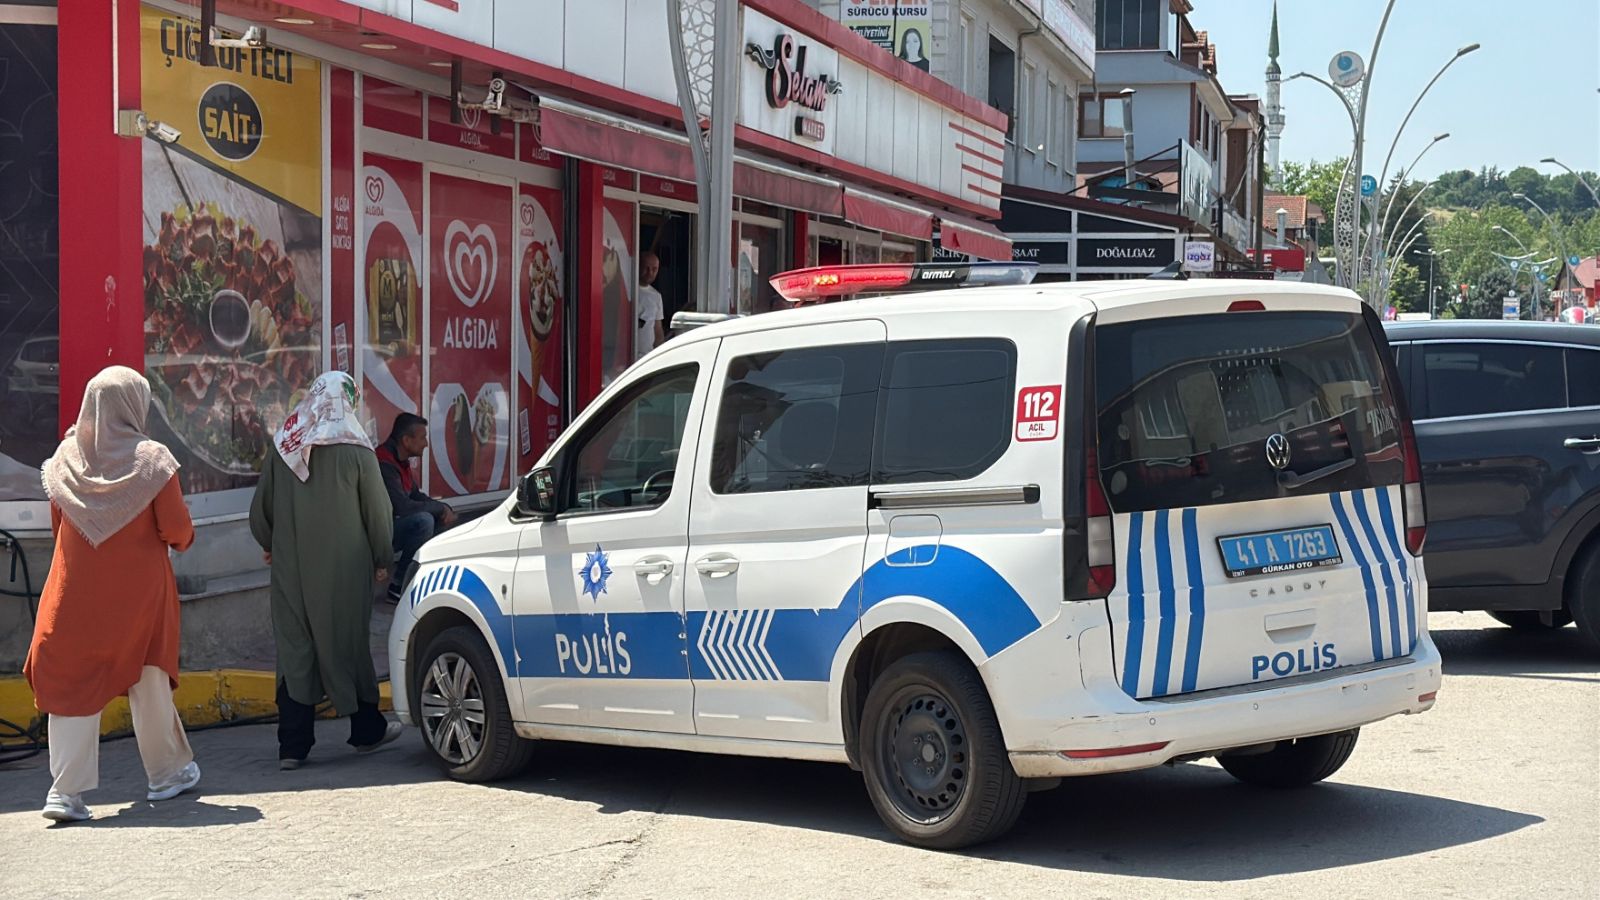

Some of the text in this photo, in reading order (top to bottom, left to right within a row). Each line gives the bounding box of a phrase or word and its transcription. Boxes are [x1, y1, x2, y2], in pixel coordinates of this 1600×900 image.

[847, 6, 927, 17] SÜRÜCÜ KURSU
[766, 34, 827, 111] Selam
[205, 103, 251, 145] SAİT
[1096, 246, 1156, 259] DOĞALGAZ
[921, 270, 956, 280] armas
[1023, 391, 1055, 418] 112
[1236, 530, 1328, 566] 41 A 7263
[1261, 562, 1296, 574] GÜRKAN
[1296, 561, 1314, 569] OTO
[1249, 580, 1327, 598] CADDY
[1252, 641, 1338, 680] POLİS
